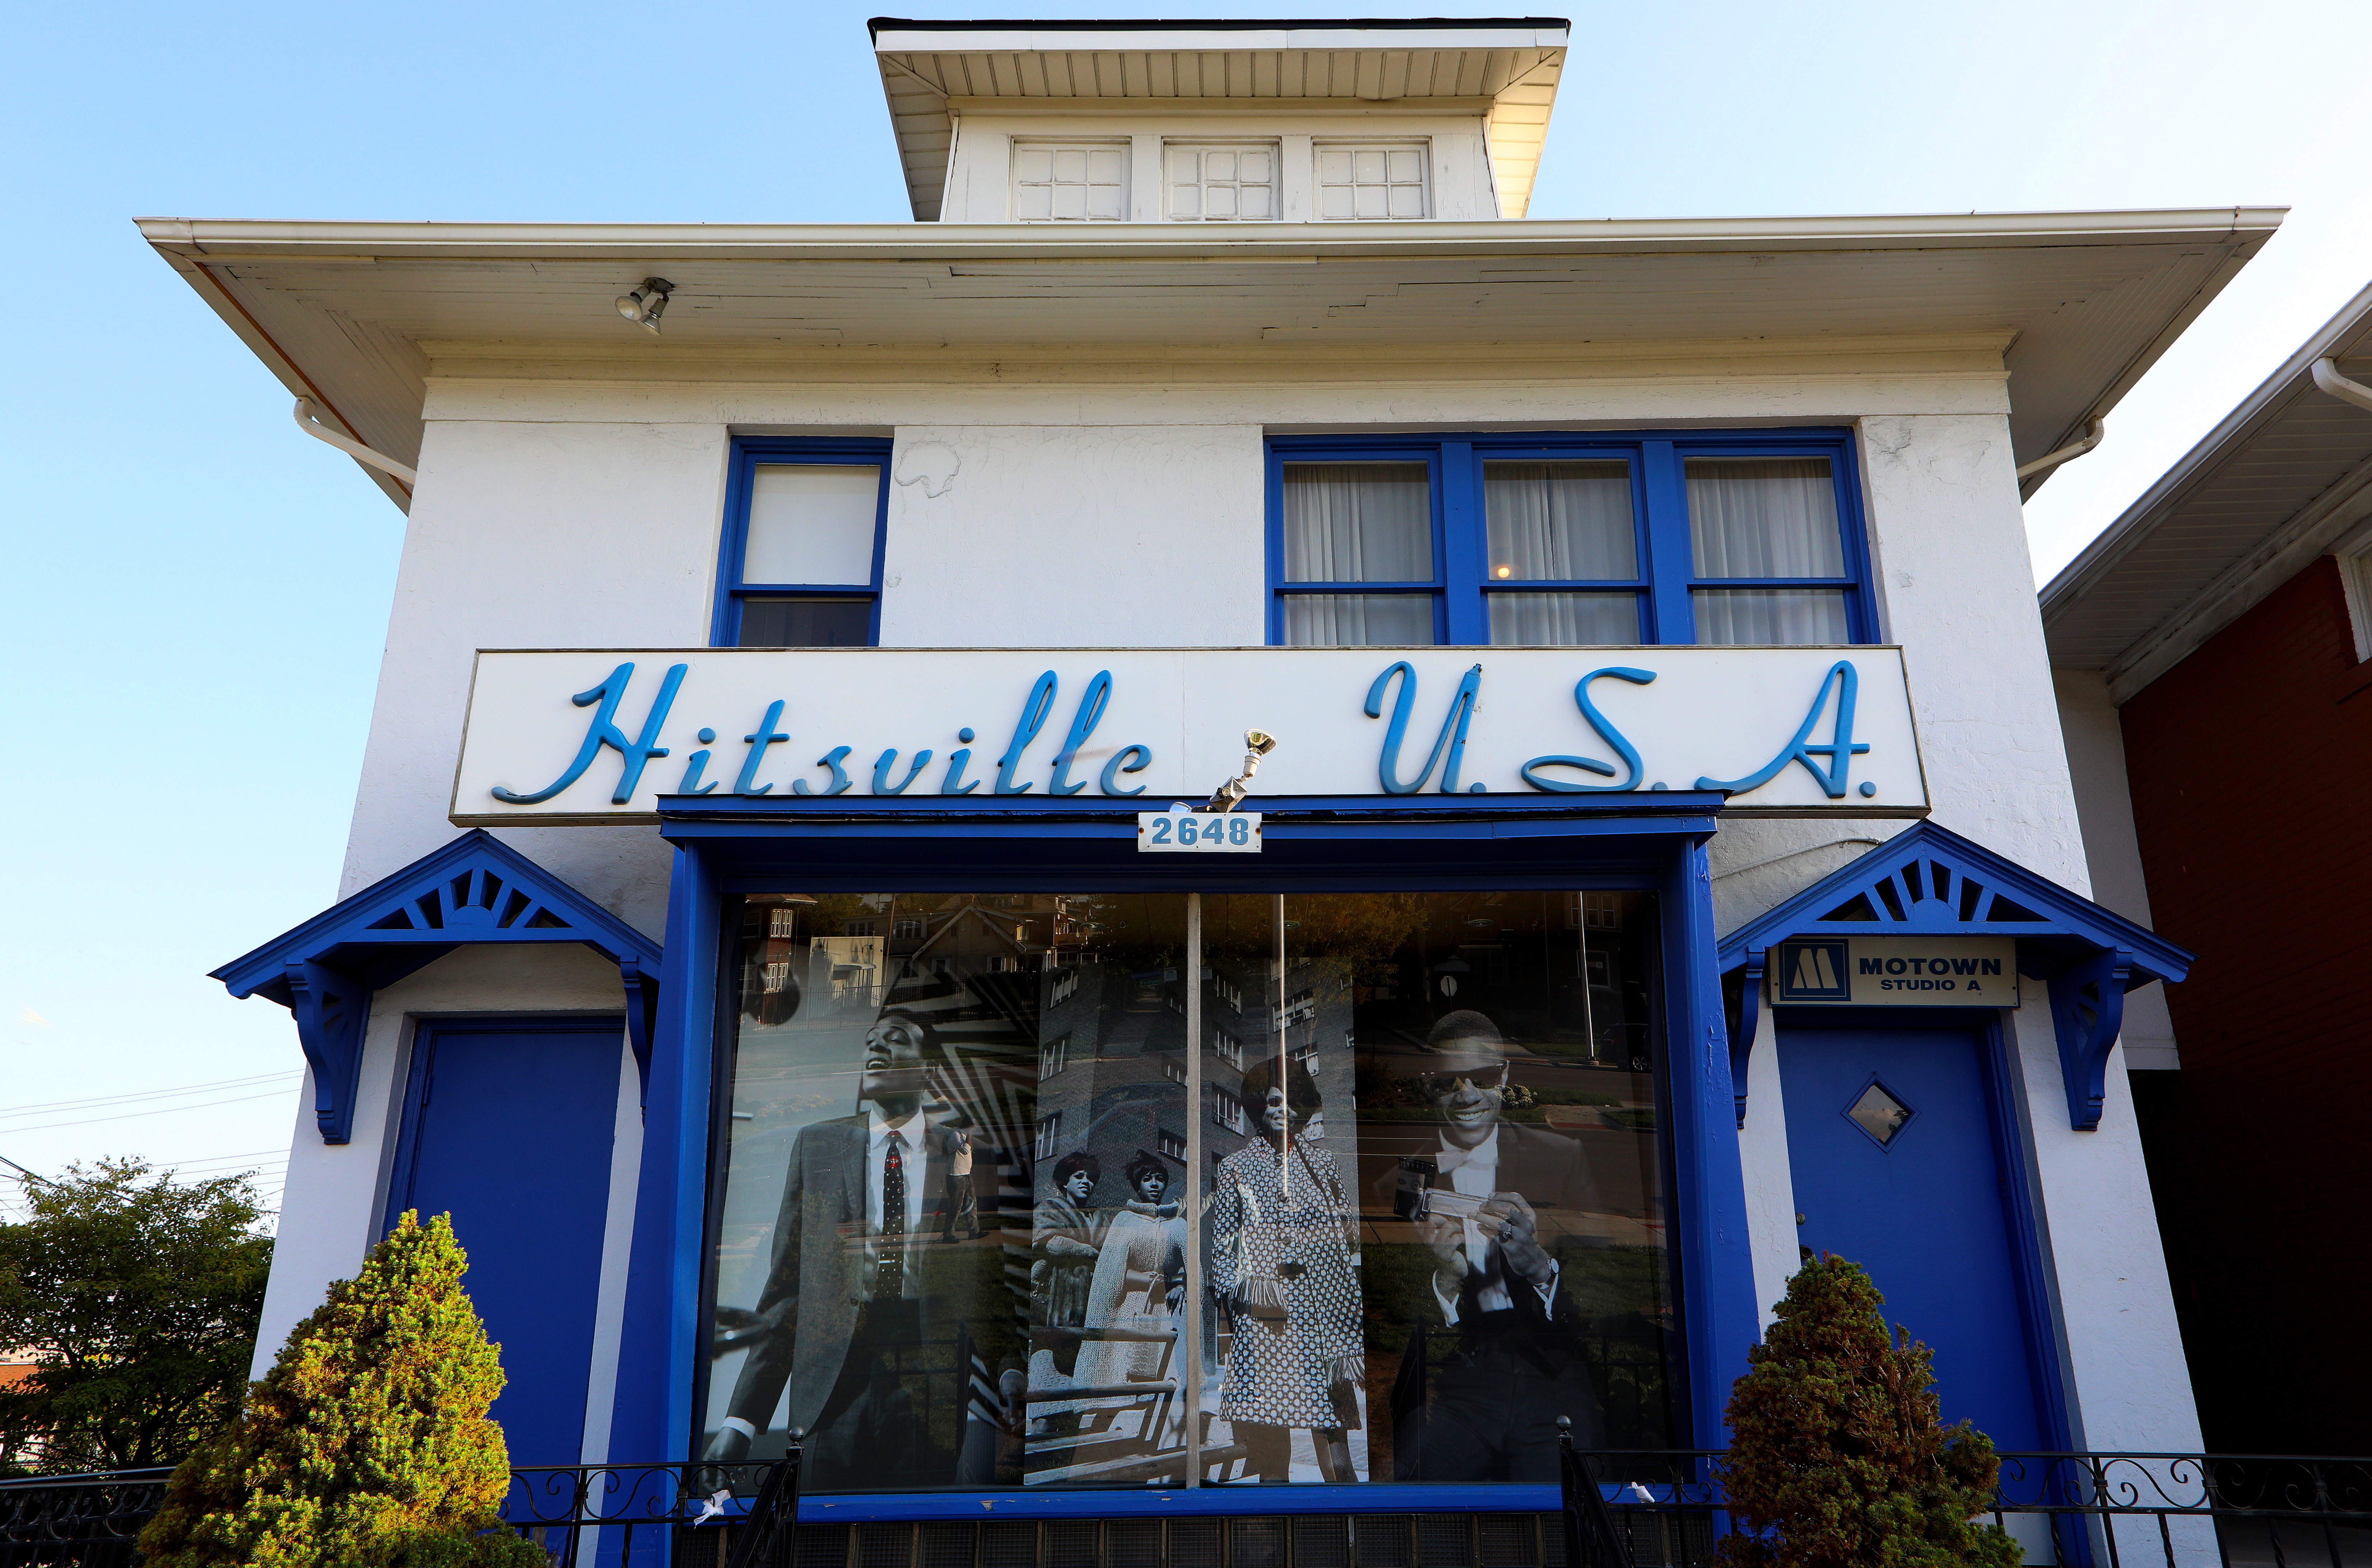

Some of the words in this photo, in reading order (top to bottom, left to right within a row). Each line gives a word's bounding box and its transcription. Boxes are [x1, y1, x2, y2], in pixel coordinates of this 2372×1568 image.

[492, 662, 1152, 804] Hitsville
[1363, 660, 1876, 798] U.S.A.
[1152, 817, 1249, 845] 2648
[1859, 958, 2001, 976] MOTOWN
[1880, 979, 1955, 991] STUDIO
[1967, 980, 1981, 991] A
